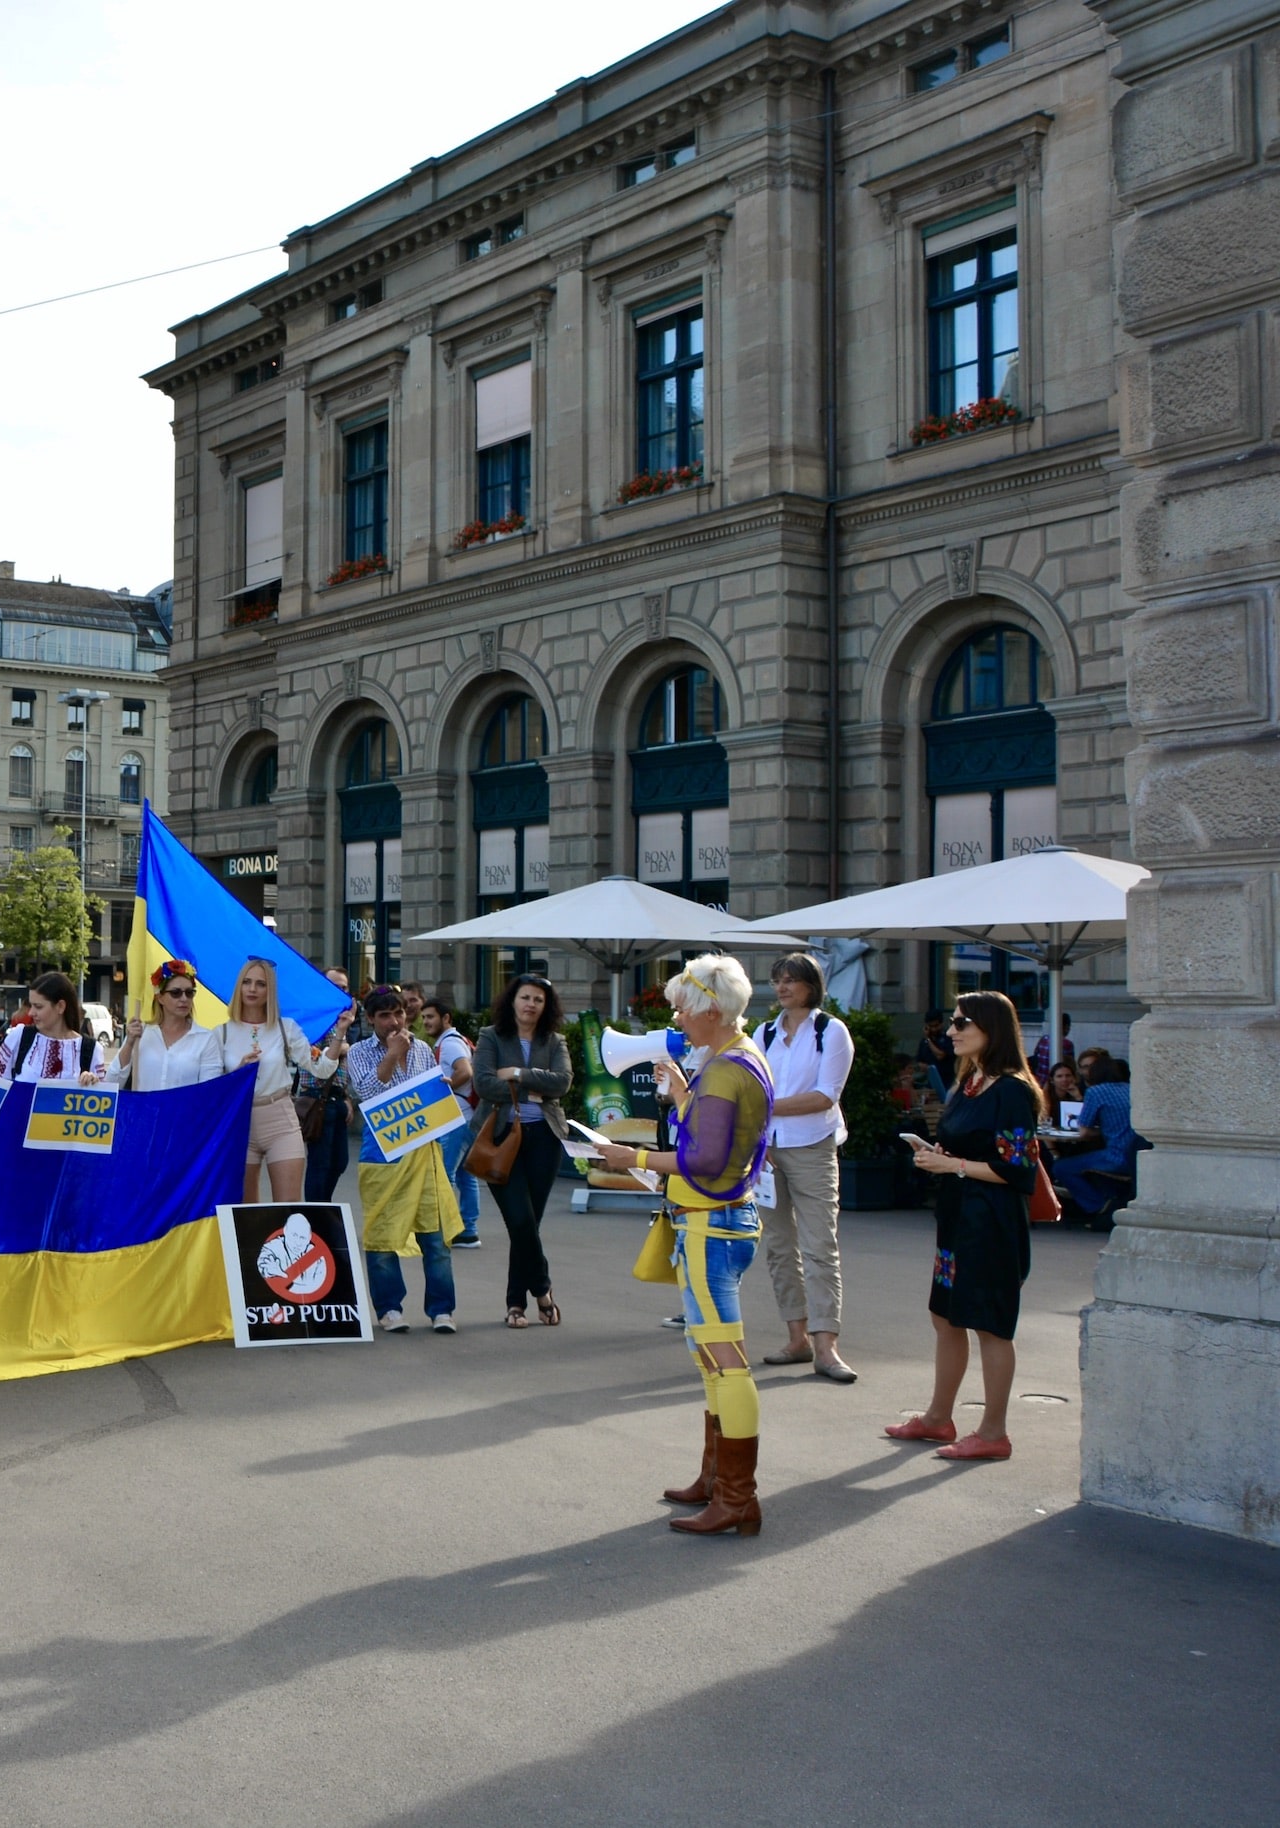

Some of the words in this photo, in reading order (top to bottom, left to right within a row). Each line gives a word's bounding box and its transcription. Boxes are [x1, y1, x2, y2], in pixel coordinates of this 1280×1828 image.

[942, 841, 982, 855] BONA
[645, 850, 675, 863] BONA
[950, 853, 976, 866] DEA
[229, 856, 262, 875] BONA
[265, 855, 278, 872] DE
[529, 862, 549, 873] BON
[650, 860, 671, 873] DEA
[705, 857, 726, 870] DEA
[485, 864, 510, 877] BONA
[534, 870, 549, 882] DE
[350, 876, 371, 888] BONA
[489, 874, 506, 886] DEA
[354, 885, 368, 896] DEA
[349, 918, 376, 932] BONA
[354, 929, 373, 942] DEA
[632, 1071, 656, 1084] ima
[632, 1089, 652, 1098] Burger
[63, 1093, 112, 1114] STOP
[369, 1091, 423, 1128] PUTIN
[62, 1119, 110, 1139] STOP
[382, 1115, 429, 1144] WAR
[299, 1304, 361, 1323] PUTIN
